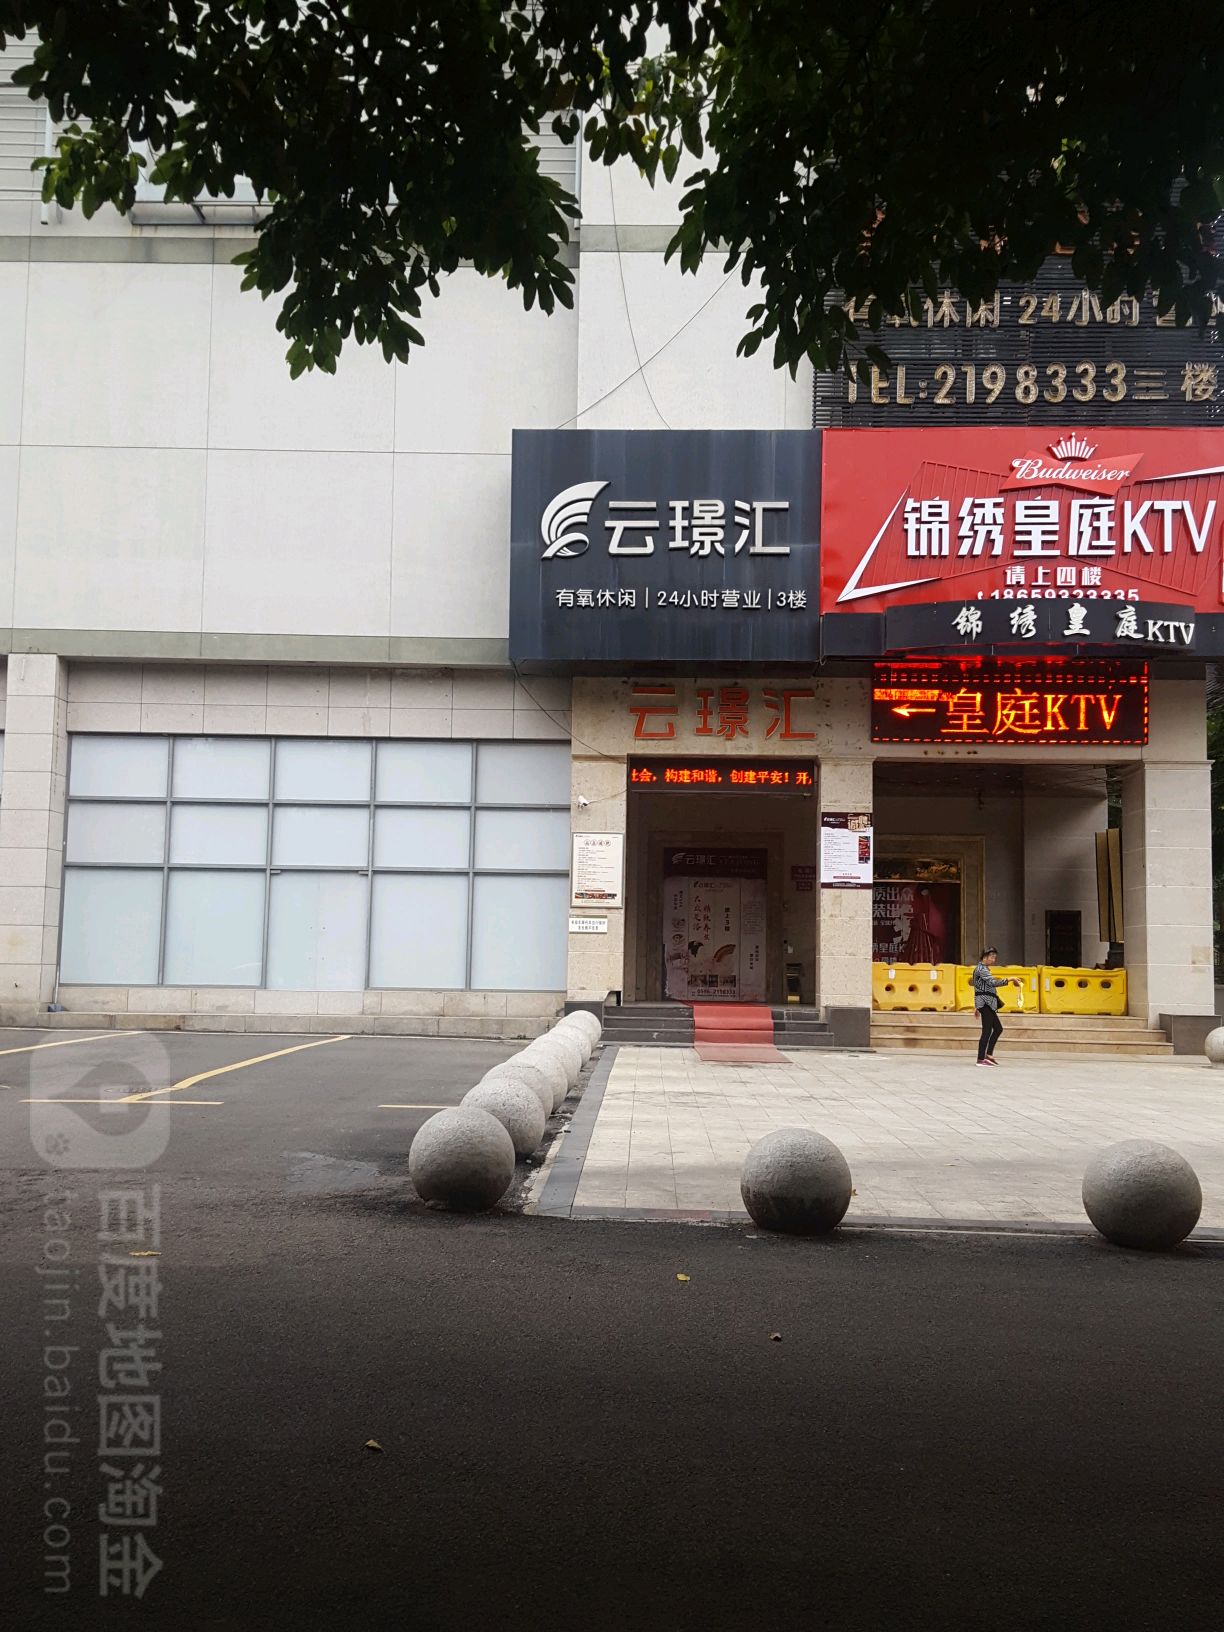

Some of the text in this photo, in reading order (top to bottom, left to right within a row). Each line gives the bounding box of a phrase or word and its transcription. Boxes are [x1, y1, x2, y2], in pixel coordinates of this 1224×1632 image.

[1011, 458, 1130, 482] Budweiser
[604, 499, 791, 557] 云璟汇
[903, 496, 1217, 556] 锦绣皇庭KTV
[555, 588, 807, 609] 有氧休闲 24小时营业 3楼
[1005, 566, 1102, 586] 请上四楼
[952, 602, 1195, 645] 锦绣皇庭KTV
[629, 686, 817, 740] 云璟汇
[940, 688, 1122, 735] 皇庭KTV
